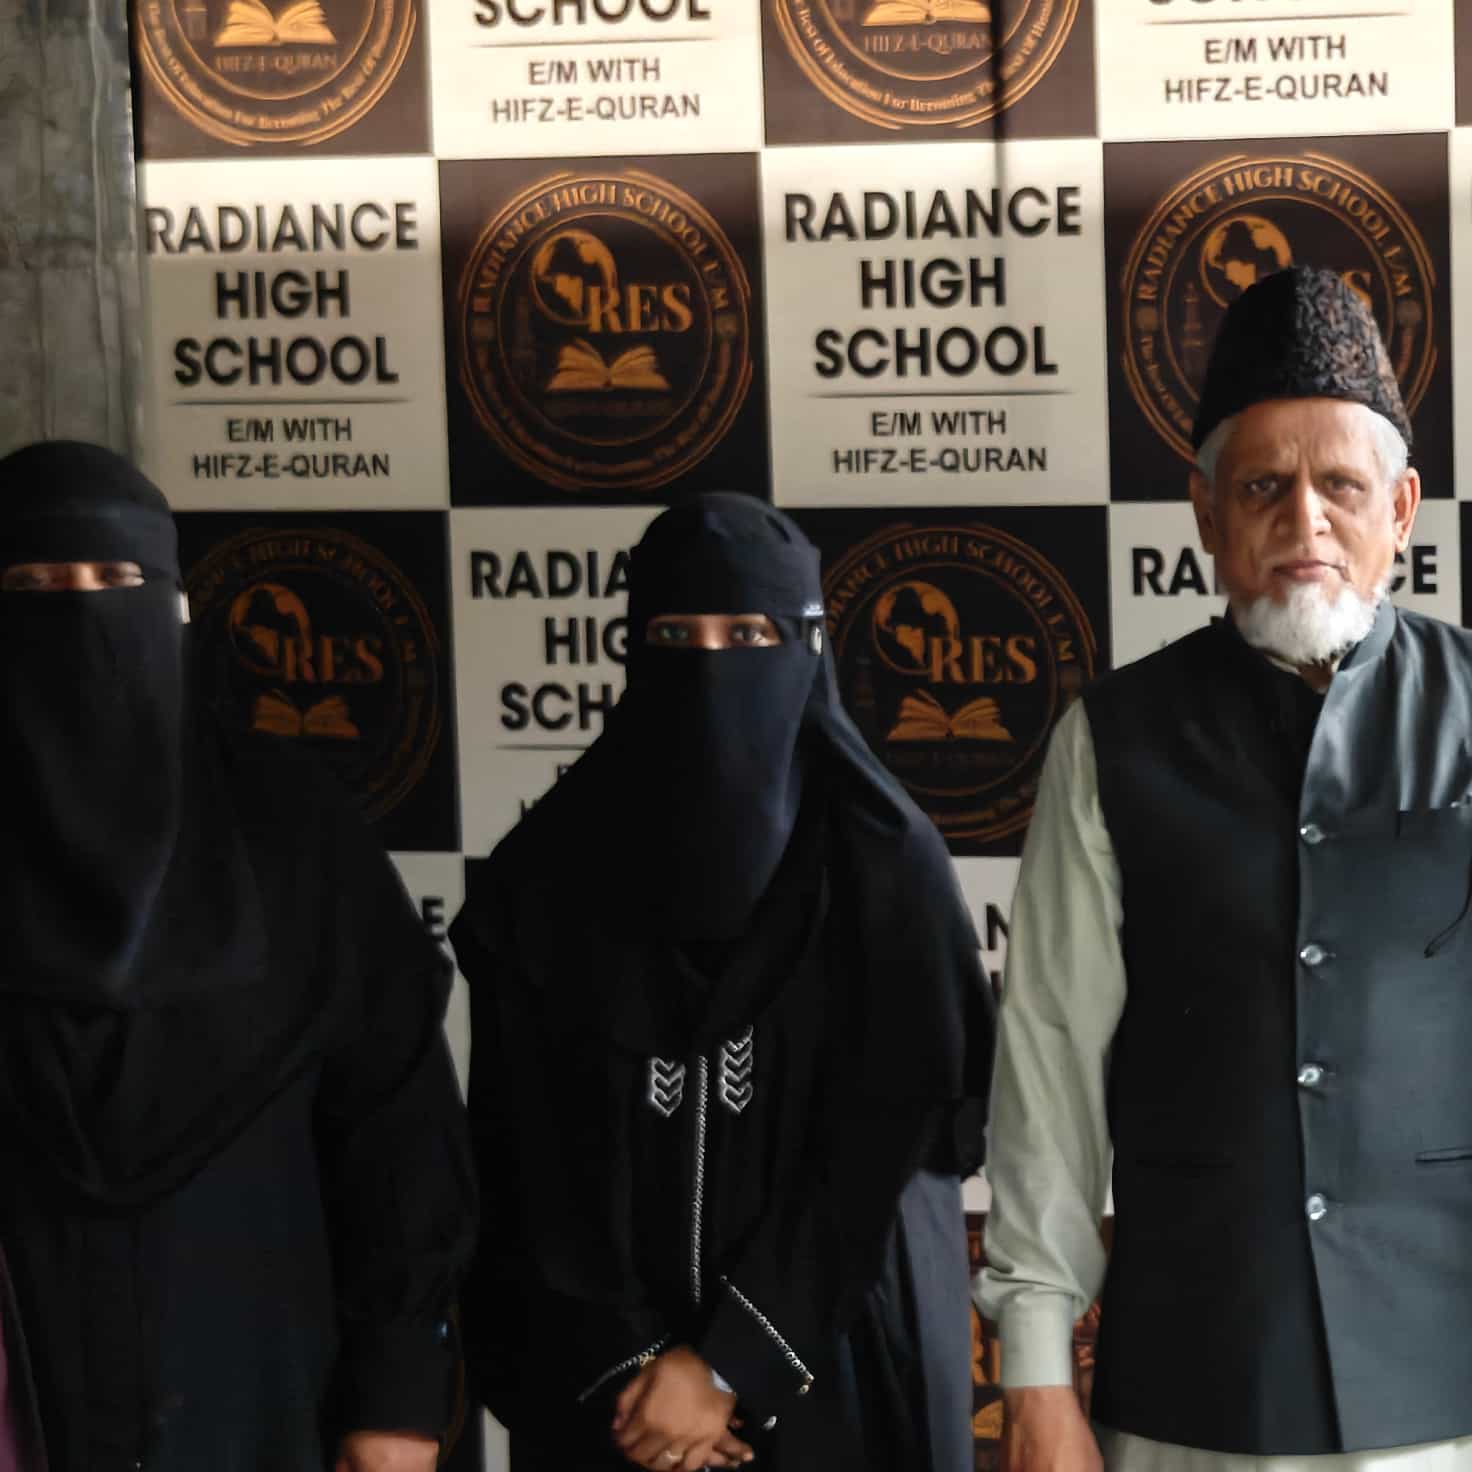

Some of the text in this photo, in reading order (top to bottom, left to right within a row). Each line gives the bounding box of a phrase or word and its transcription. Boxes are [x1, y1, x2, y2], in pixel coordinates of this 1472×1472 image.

[529, 58, 660, 85] E/M WITH
[1205, 35, 1345, 63] E/M WITH
[492, 94, 699, 122] HIFZ-E-QURAN
[1165, 72, 1387, 102] HIFZ-E-QURAN
[145, 203, 418, 255] RADIANCE
[785, 186, 1080, 242] RADIANCE
[216, 270, 349, 318] HIGH
[860, 257, 1005, 308] HIGH
[584, 283, 692, 333] RES
[174, 336, 398, 386] SCHOOL
[816, 326, 1057, 378] SCHOOL
[227, 418, 351, 442] E/M WITH
[872, 411, 1006, 436] E/M WITH
[193, 453, 389, 478] HIFZ-E-QURAN
[833, 448, 1046, 473] HIFZ-E-QURAN
[470, 550, 629, 599] RADIA
[544, 617, 627, 664] HIG
[930, 635, 1038, 684] RES
[500, 683, 614, 730] SCH
